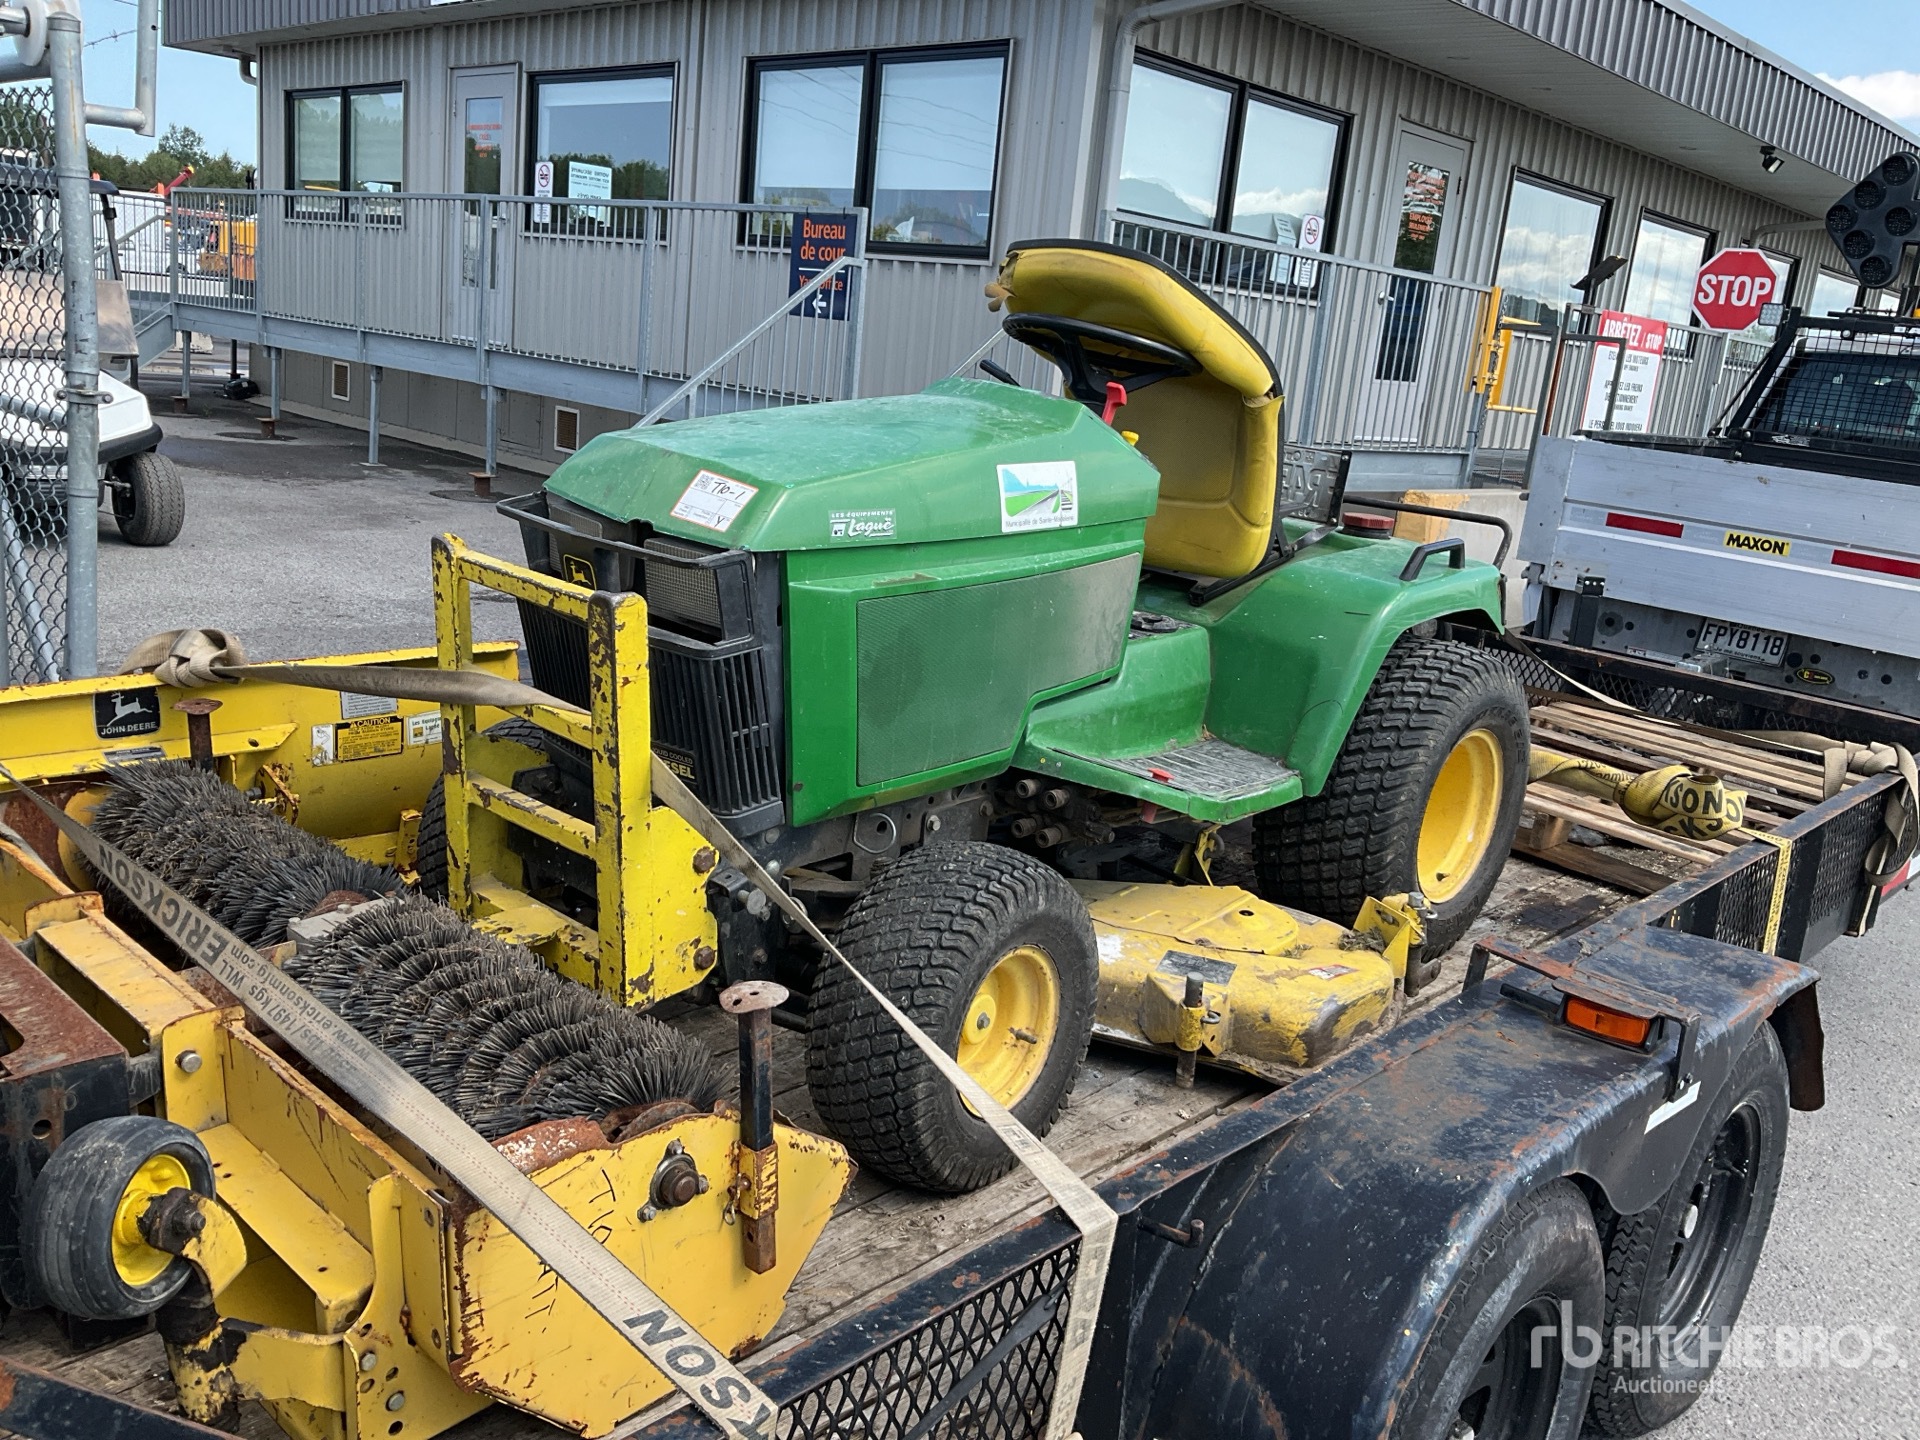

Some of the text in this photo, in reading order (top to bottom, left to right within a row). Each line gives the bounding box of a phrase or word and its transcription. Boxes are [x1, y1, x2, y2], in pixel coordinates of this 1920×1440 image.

[803, 219, 846, 240] Bureau
[800, 240, 816, 260] de
[1698, 274, 1771, 307] STOP
[1602, 317, 1642, 347] ARRÊTEZ
[1645, 332, 1663, 350] STOP
[846, 510, 893, 518] ÉQUIPEMENTS
[1726, 533, 1786, 555] MAXON
[1702, 623, 1785, 656] FPY8118
[101, 721, 156, 735] JOHN DEERE
[357, 717, 391, 727] CAUTION
[668, 751, 693, 765] COOLED
[99, 844, 229, 967] ERICKSON
[218, 959, 246, 990] WLL
[230, 944, 370, 1061] www.ericksonmfg.com
